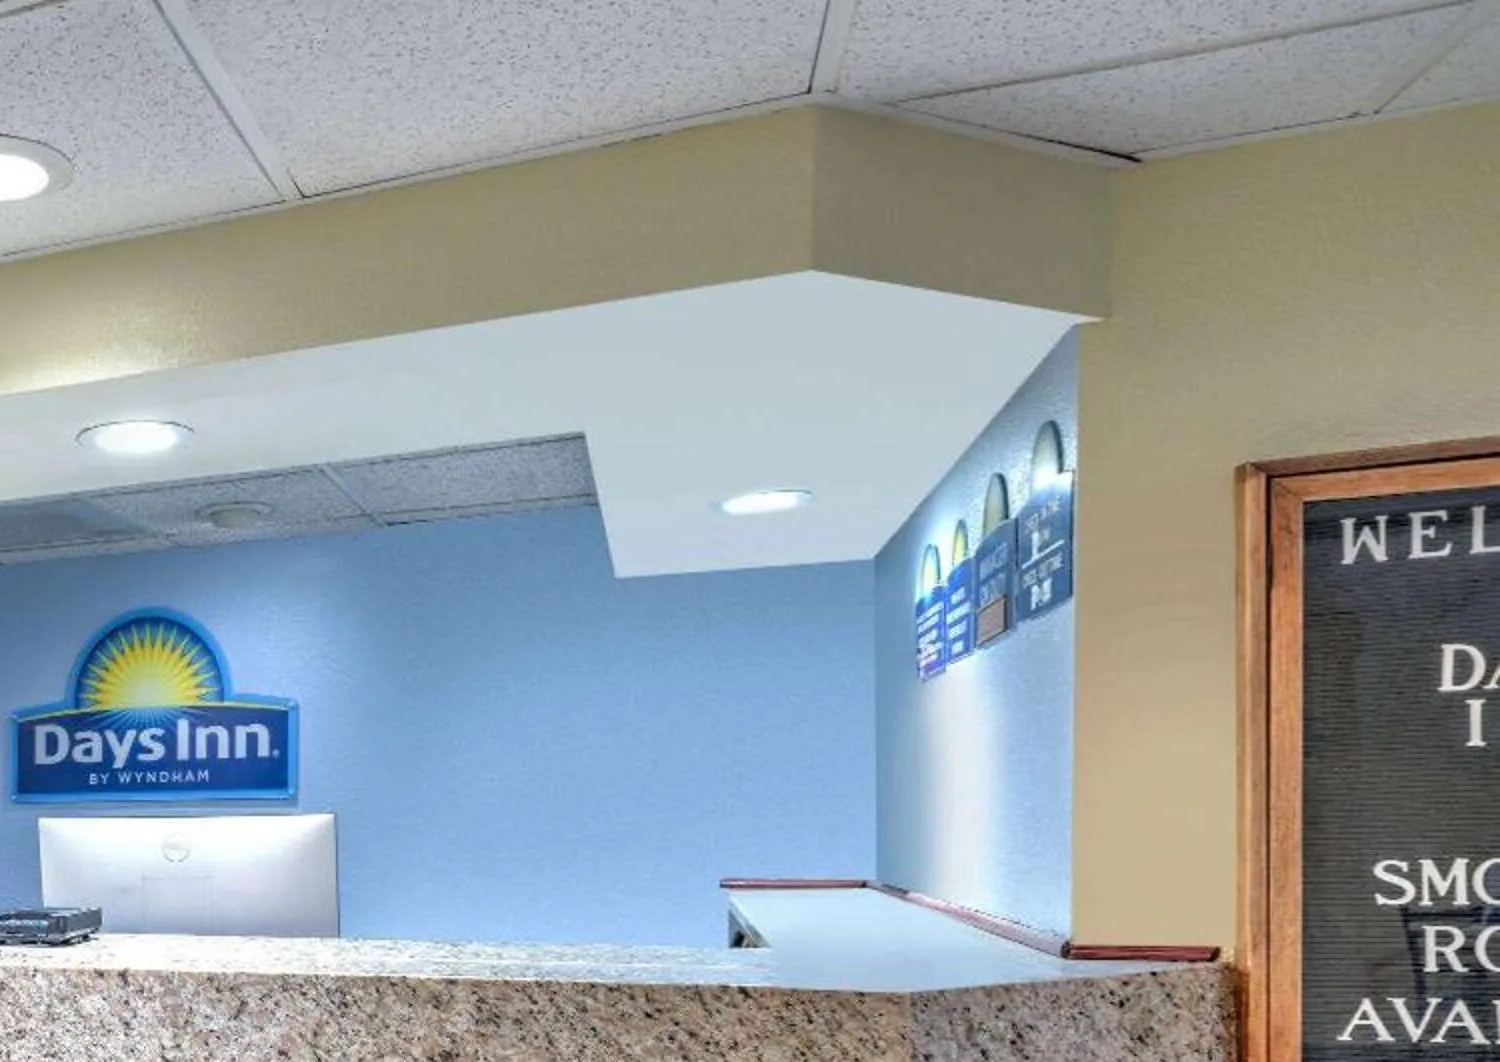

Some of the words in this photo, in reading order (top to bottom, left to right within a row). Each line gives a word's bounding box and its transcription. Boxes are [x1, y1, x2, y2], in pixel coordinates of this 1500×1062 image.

[1339, 505, 1500, 565] WEL
[1436, 643, 1500, 692] D
[33, 723, 167, 769] Days
[88, 772, 109, 785] BY
[118, 770, 211, 784] WYNDHAM
